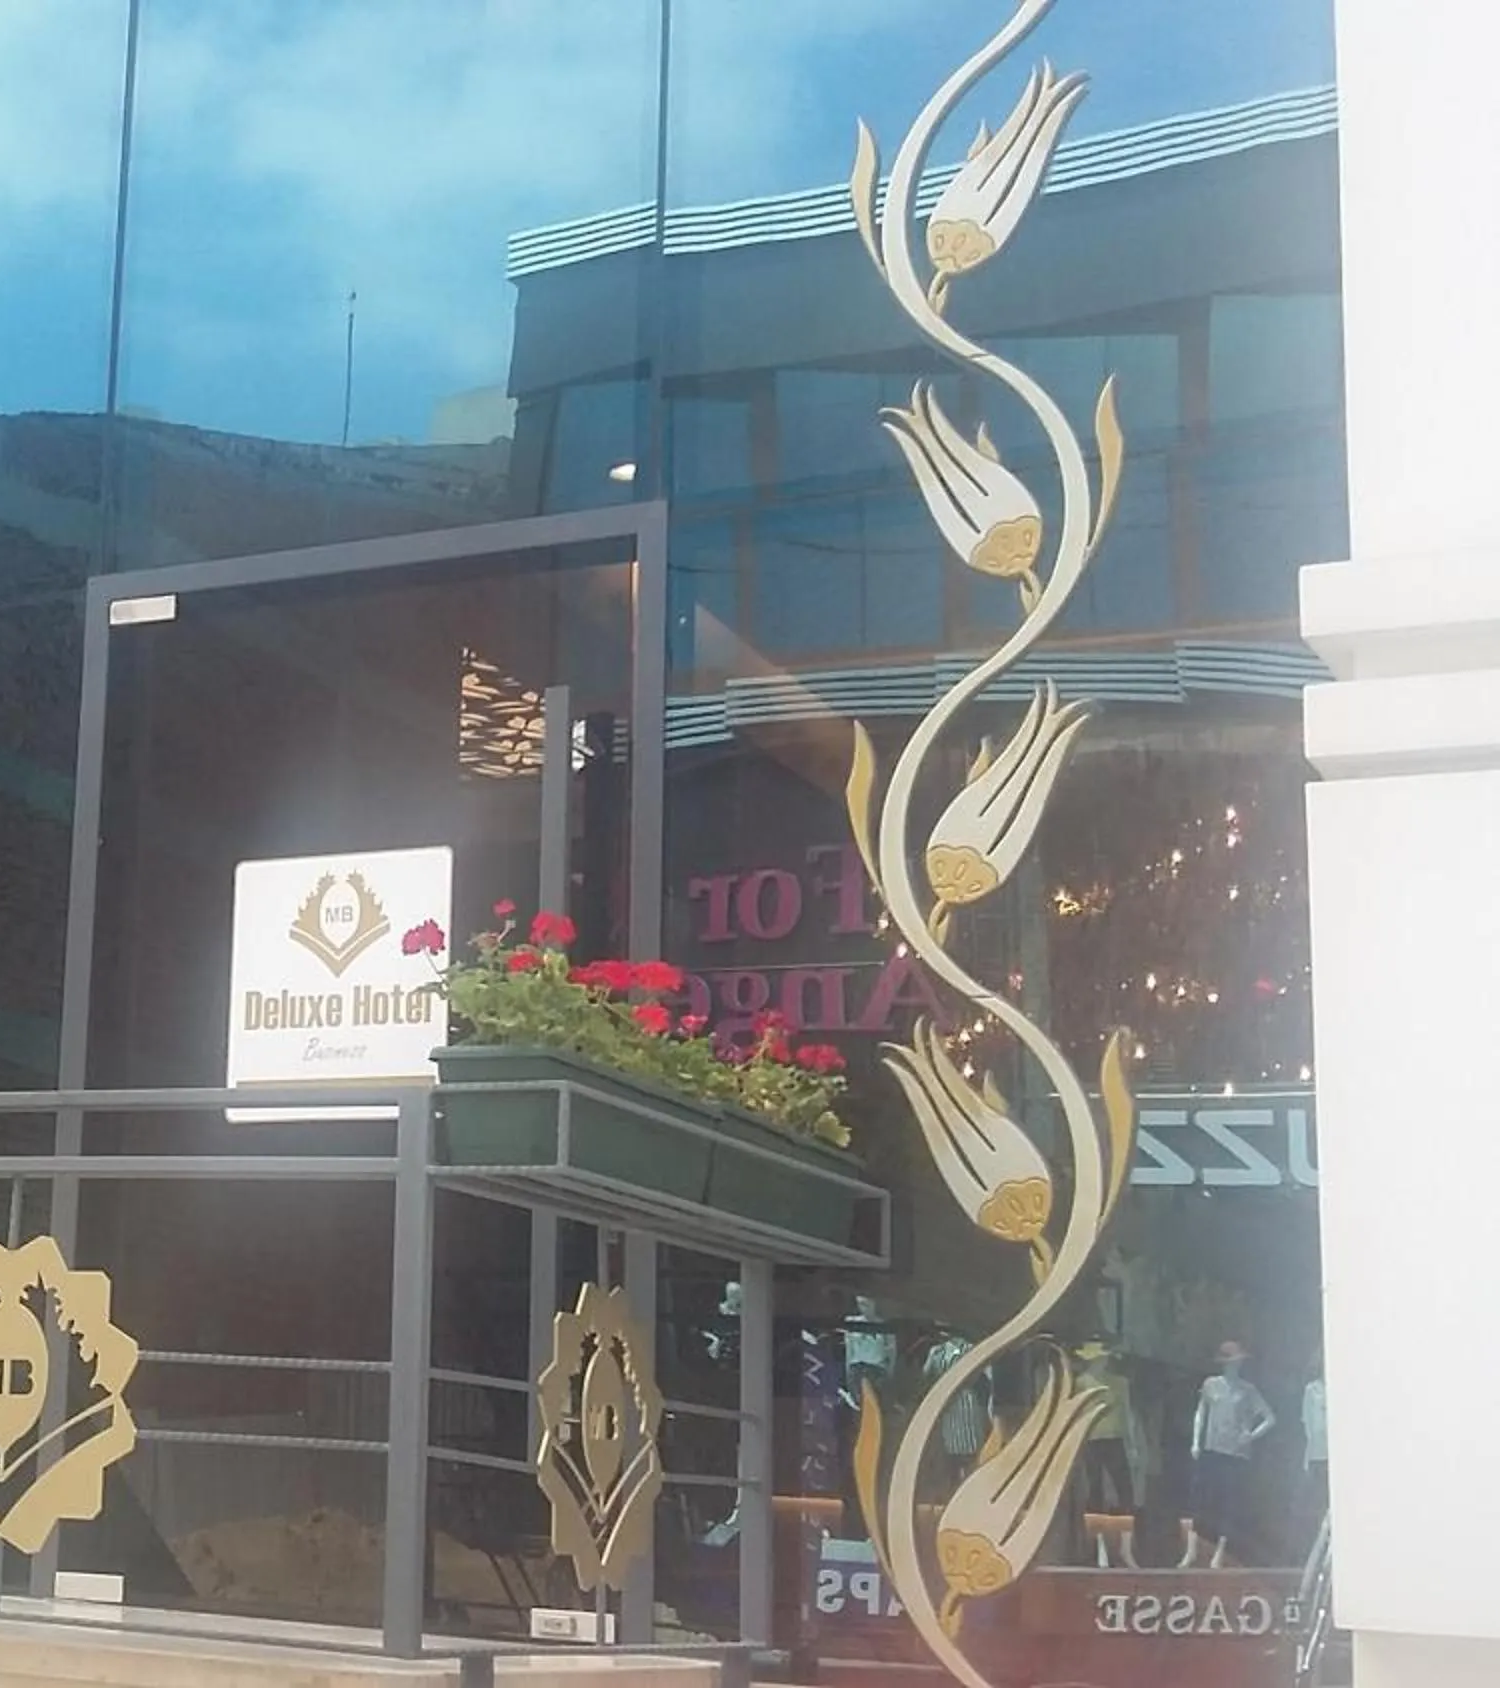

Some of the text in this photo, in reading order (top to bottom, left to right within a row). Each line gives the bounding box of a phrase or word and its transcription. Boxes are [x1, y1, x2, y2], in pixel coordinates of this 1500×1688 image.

[324, 905, 353, 924] MB
[244, 984, 432, 1031] Deluxe Hotel
